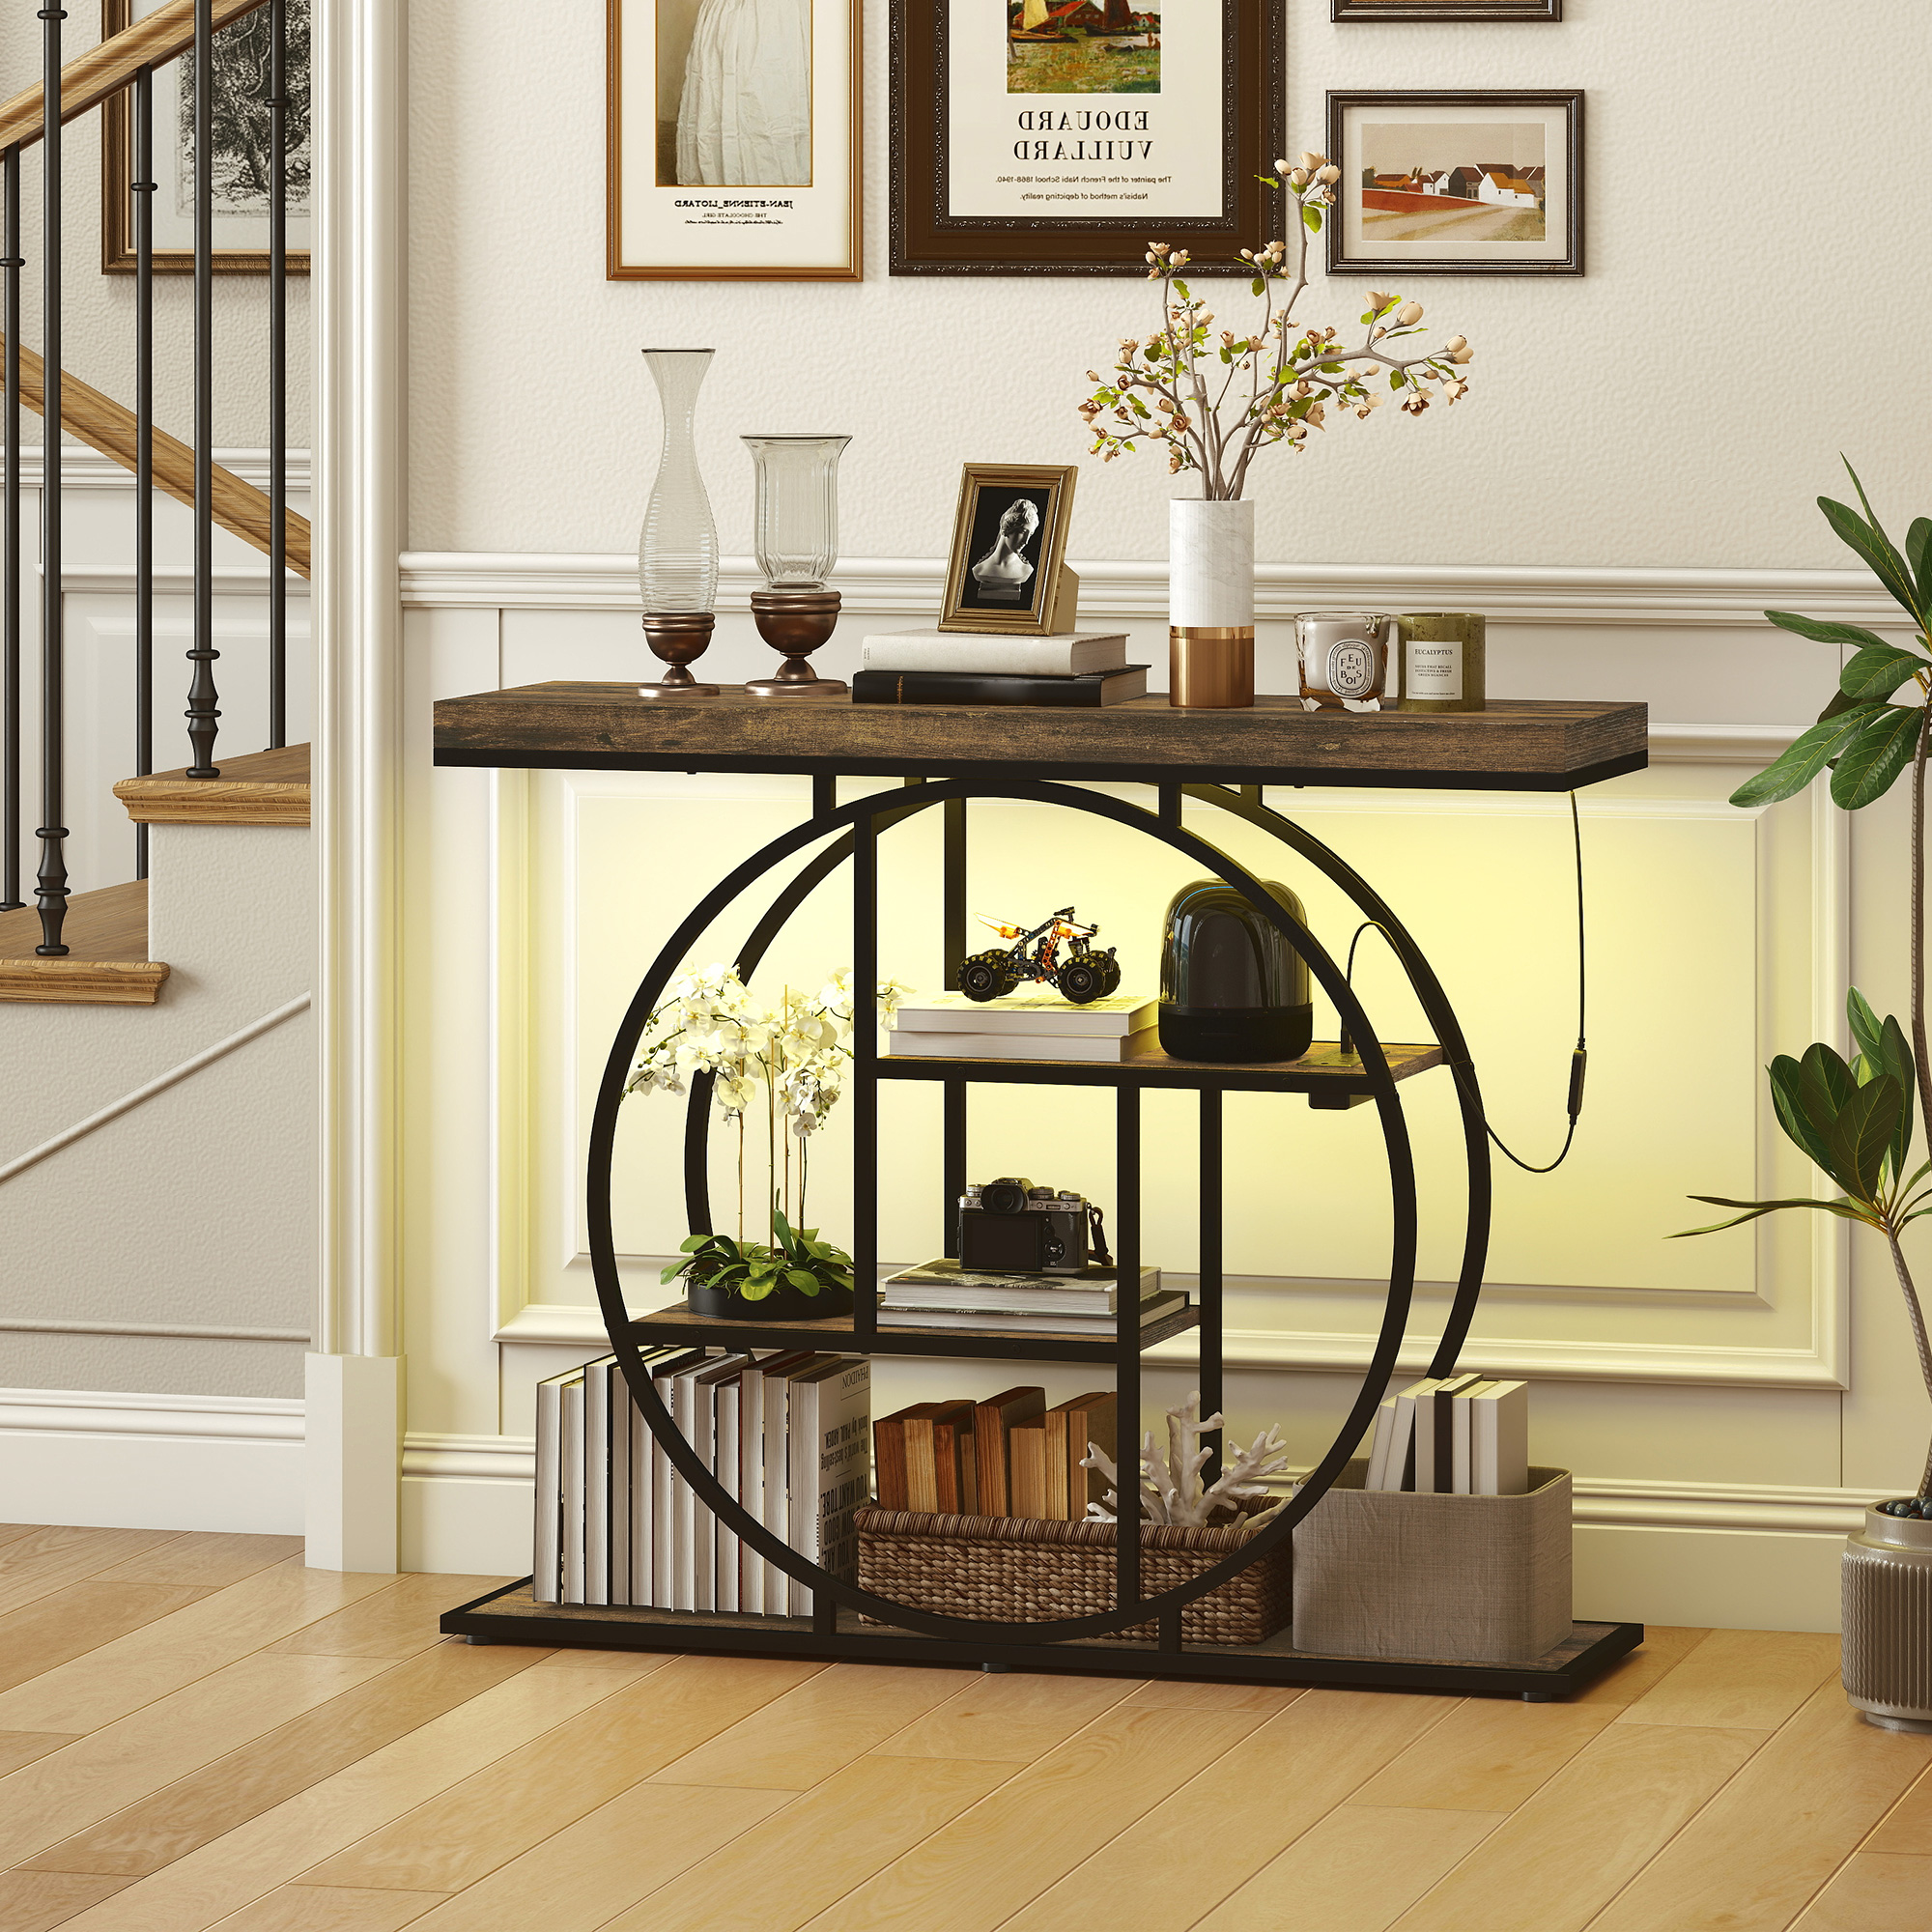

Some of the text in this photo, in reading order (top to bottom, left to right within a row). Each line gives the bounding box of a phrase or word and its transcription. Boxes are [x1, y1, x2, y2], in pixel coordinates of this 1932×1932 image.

[1340, 669, 1363, 685] BOIS
[842, 1365, 868, 1389] PHAIDON
[823, 1516, 839, 1546] GOOD
